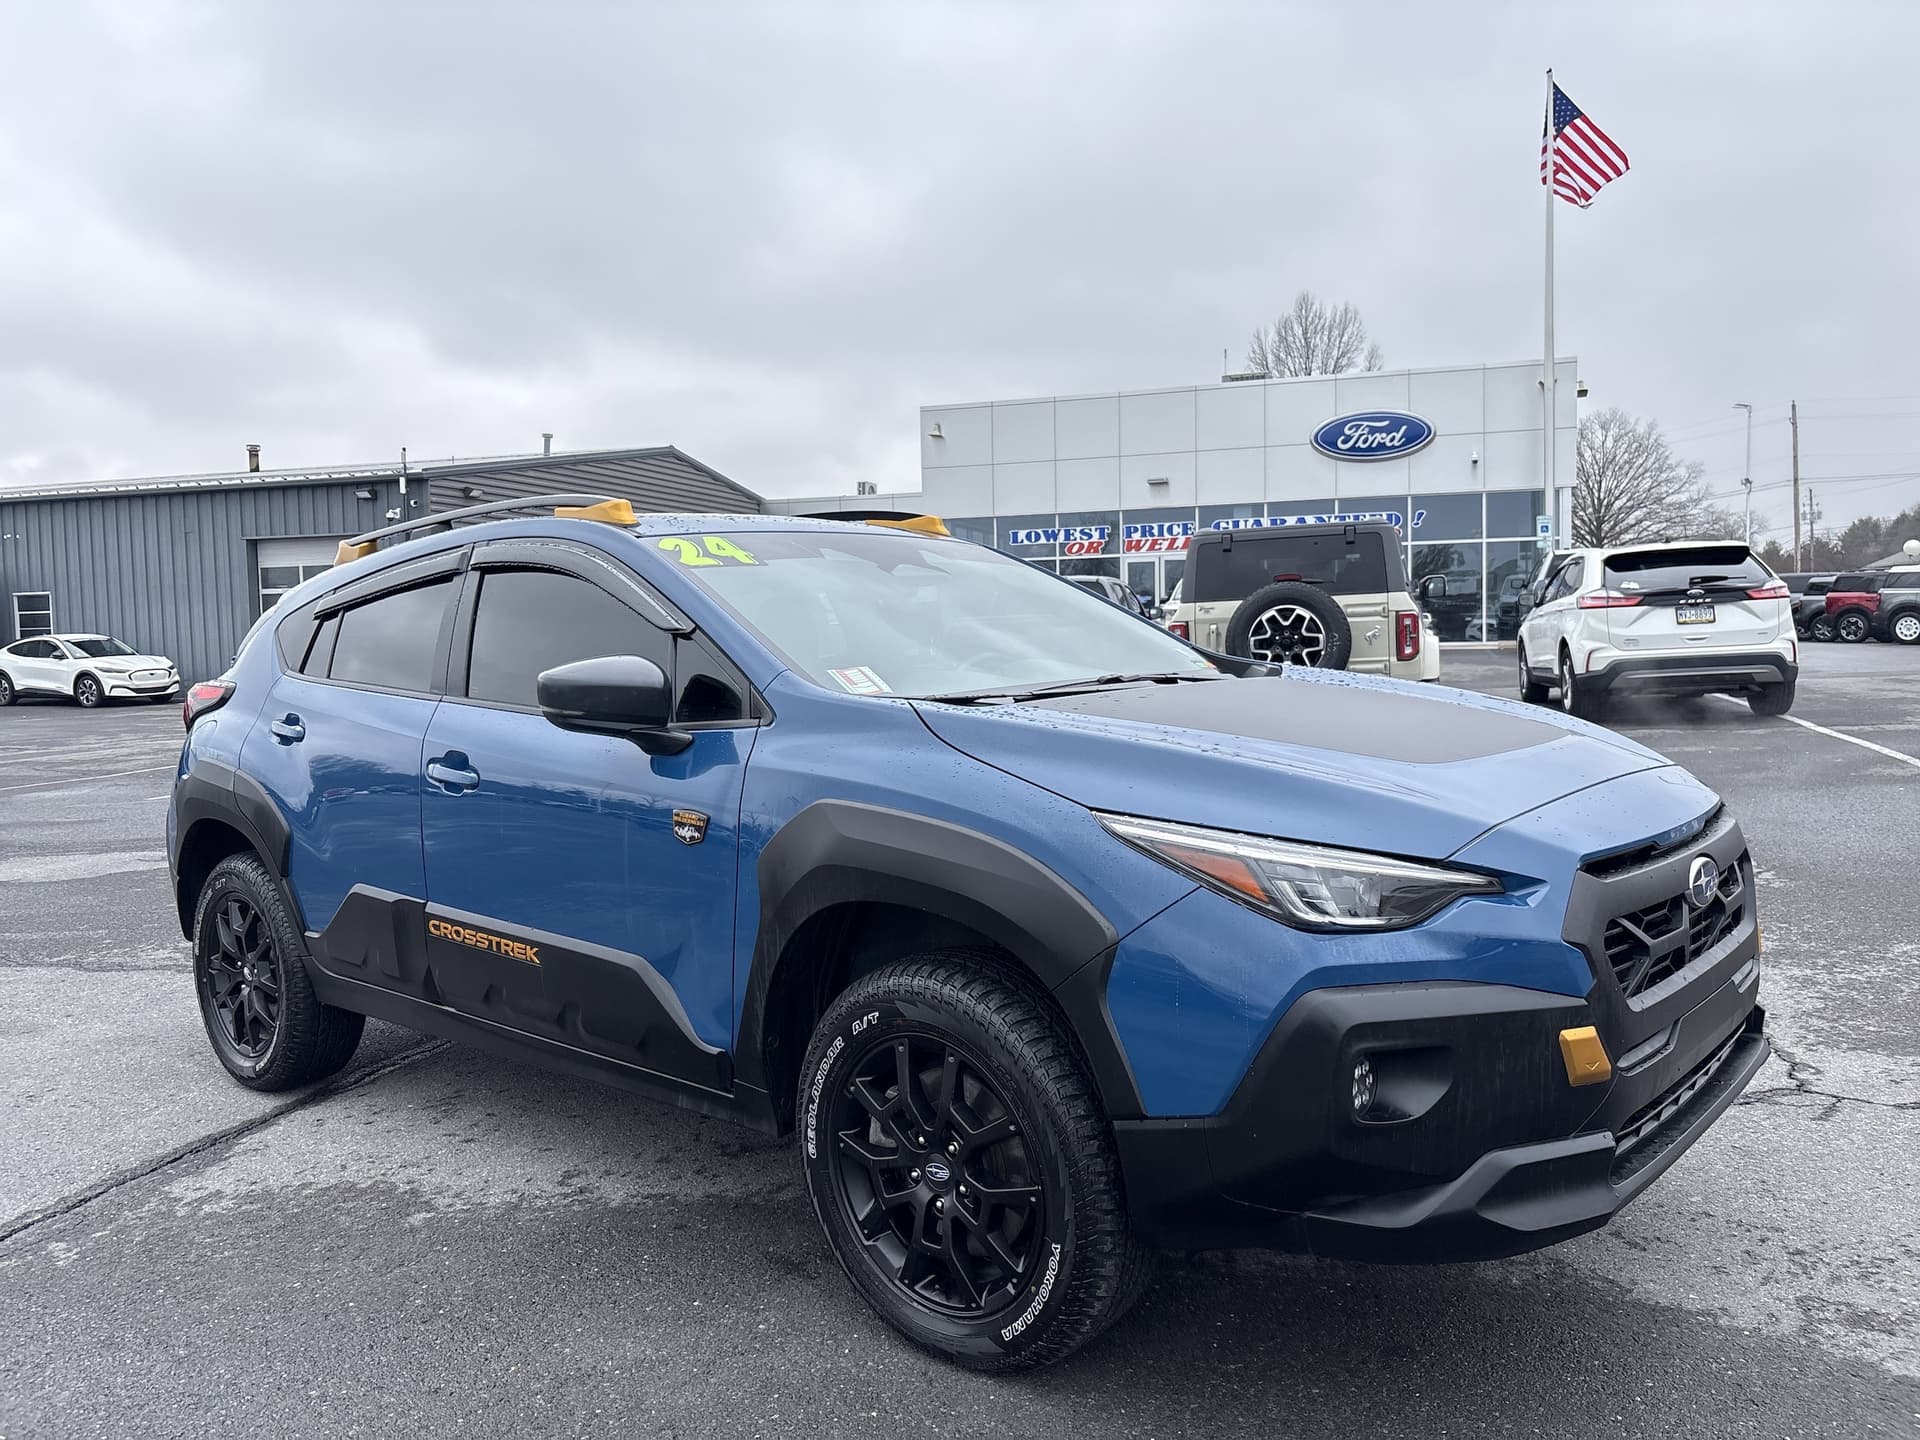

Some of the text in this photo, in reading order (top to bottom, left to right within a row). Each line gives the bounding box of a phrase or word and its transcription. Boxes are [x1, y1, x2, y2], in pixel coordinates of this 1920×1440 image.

[1336, 420, 1408, 450] Ford
[1009, 525, 1111, 545] LOWEST
[1123, 521, 1195, 539] PRICE
[1211, 511, 1402, 531] GUARAND
[657, 536, 760, 567] 24
[1065, 540, 1104, 555] OR
[428, 919, 541, 964] CROSSTREK
[807, 1036, 845, 1160] GEOLANDAR
[852, 1011, 880, 1035] A/T
[1001, 1242, 1061, 1341] YOKOHAMA
